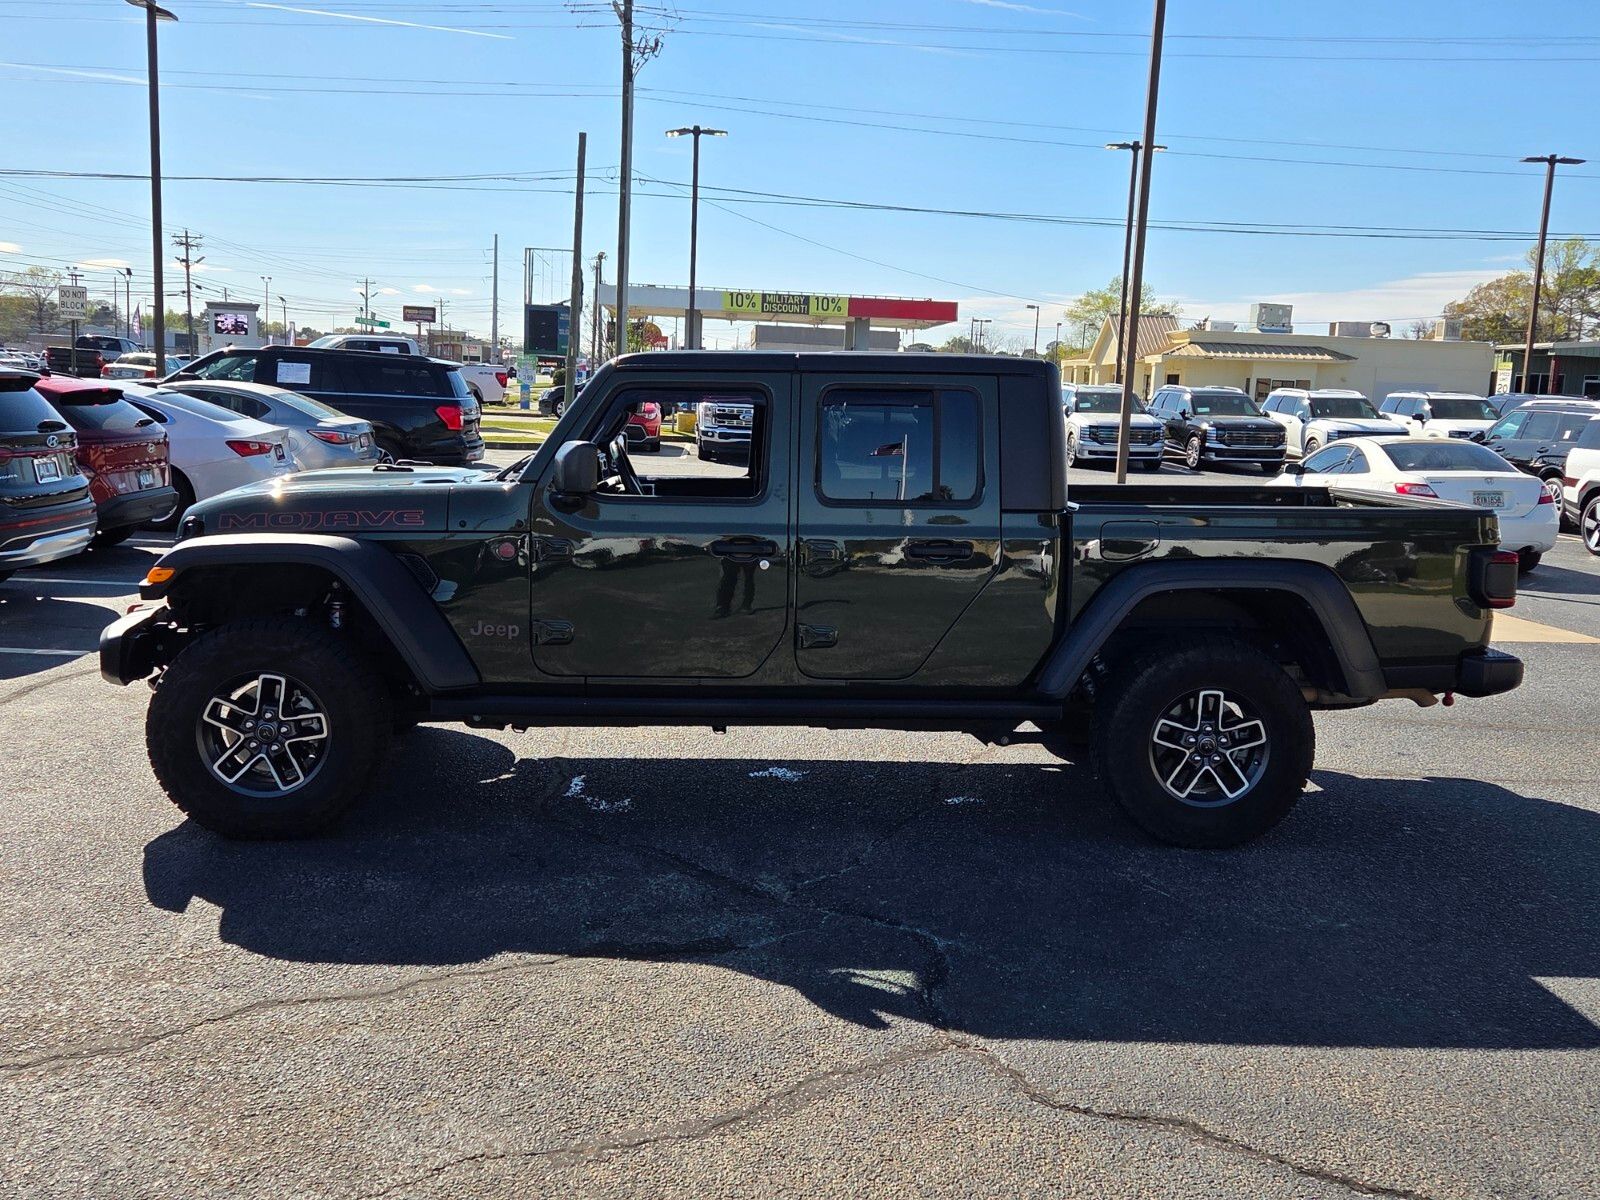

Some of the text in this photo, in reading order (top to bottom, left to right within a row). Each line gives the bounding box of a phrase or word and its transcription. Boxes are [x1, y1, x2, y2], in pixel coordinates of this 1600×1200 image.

[61, 290, 85, 299] DO NOT
[729, 292, 756, 308] 10%
[766, 294, 805, 304] MILITARY
[61, 301, 85, 309] BLOCK
[763, 303, 808, 313] DISCOUNT!
[815, 297, 842, 312] 10%
[219, 510, 424, 529] MOJAVE
[470, 620, 520, 640] Jeep
